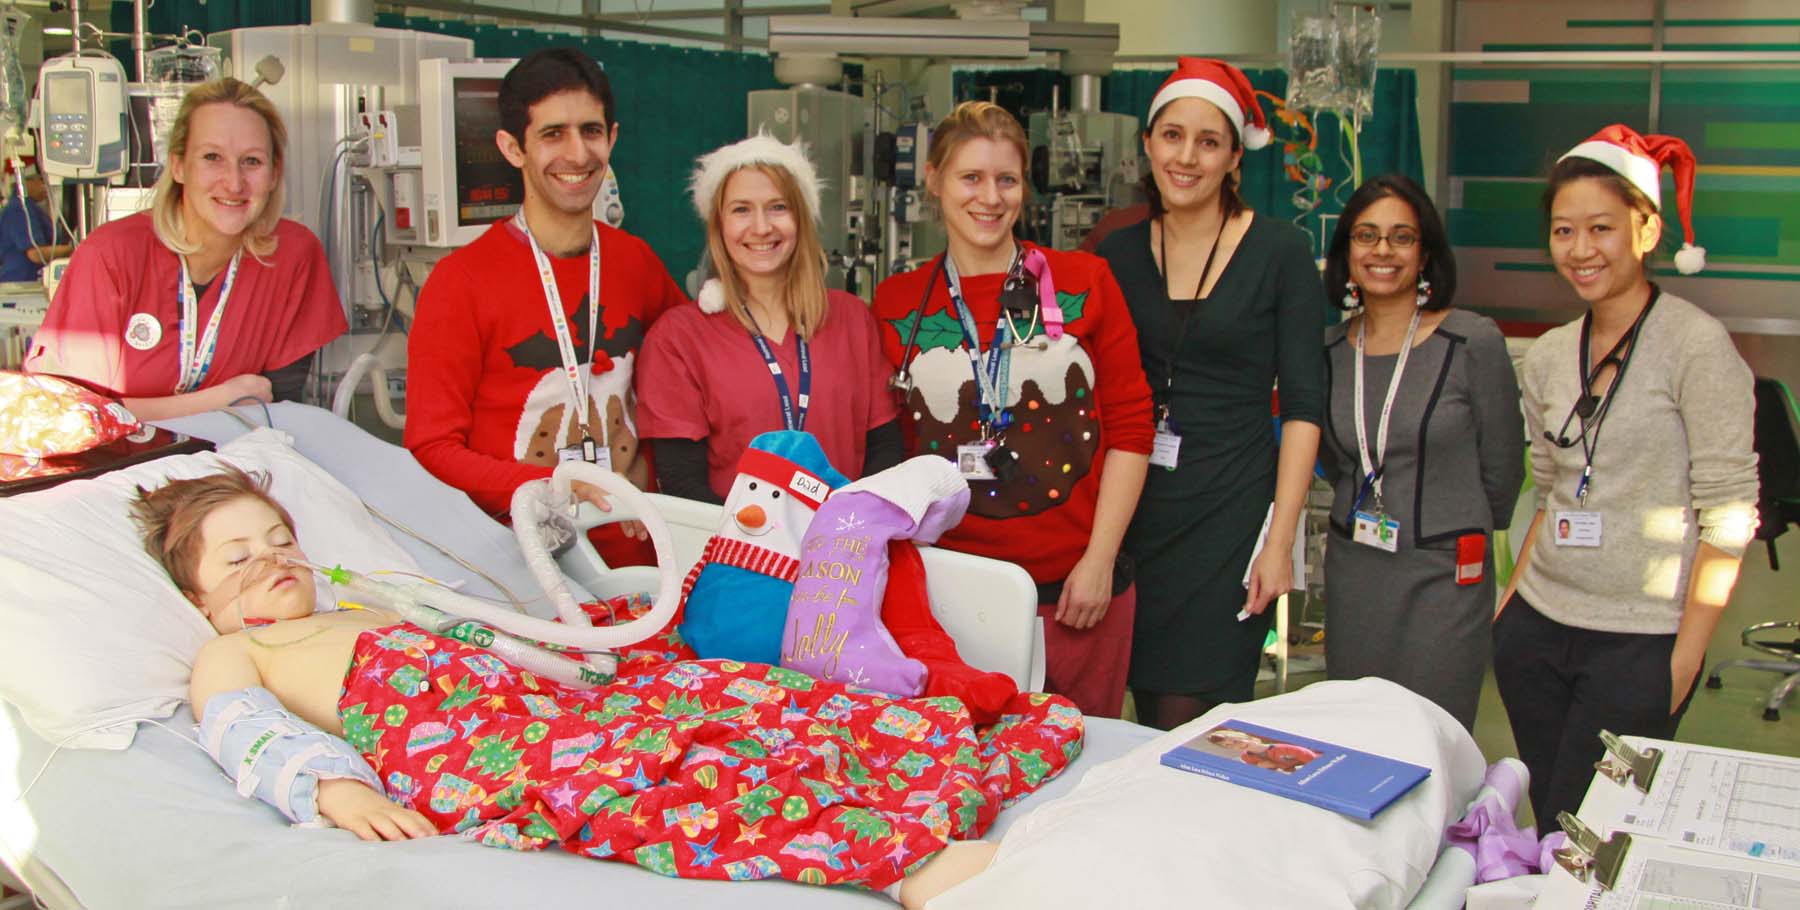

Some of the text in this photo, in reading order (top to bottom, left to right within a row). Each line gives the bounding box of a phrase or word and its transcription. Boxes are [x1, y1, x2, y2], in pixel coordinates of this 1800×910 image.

[797, 476, 820, 495] Dad
[800, 559, 862, 587] ASON
[783, 612, 849, 680] Jolly
[243, 729, 278, 766] X SMALL
